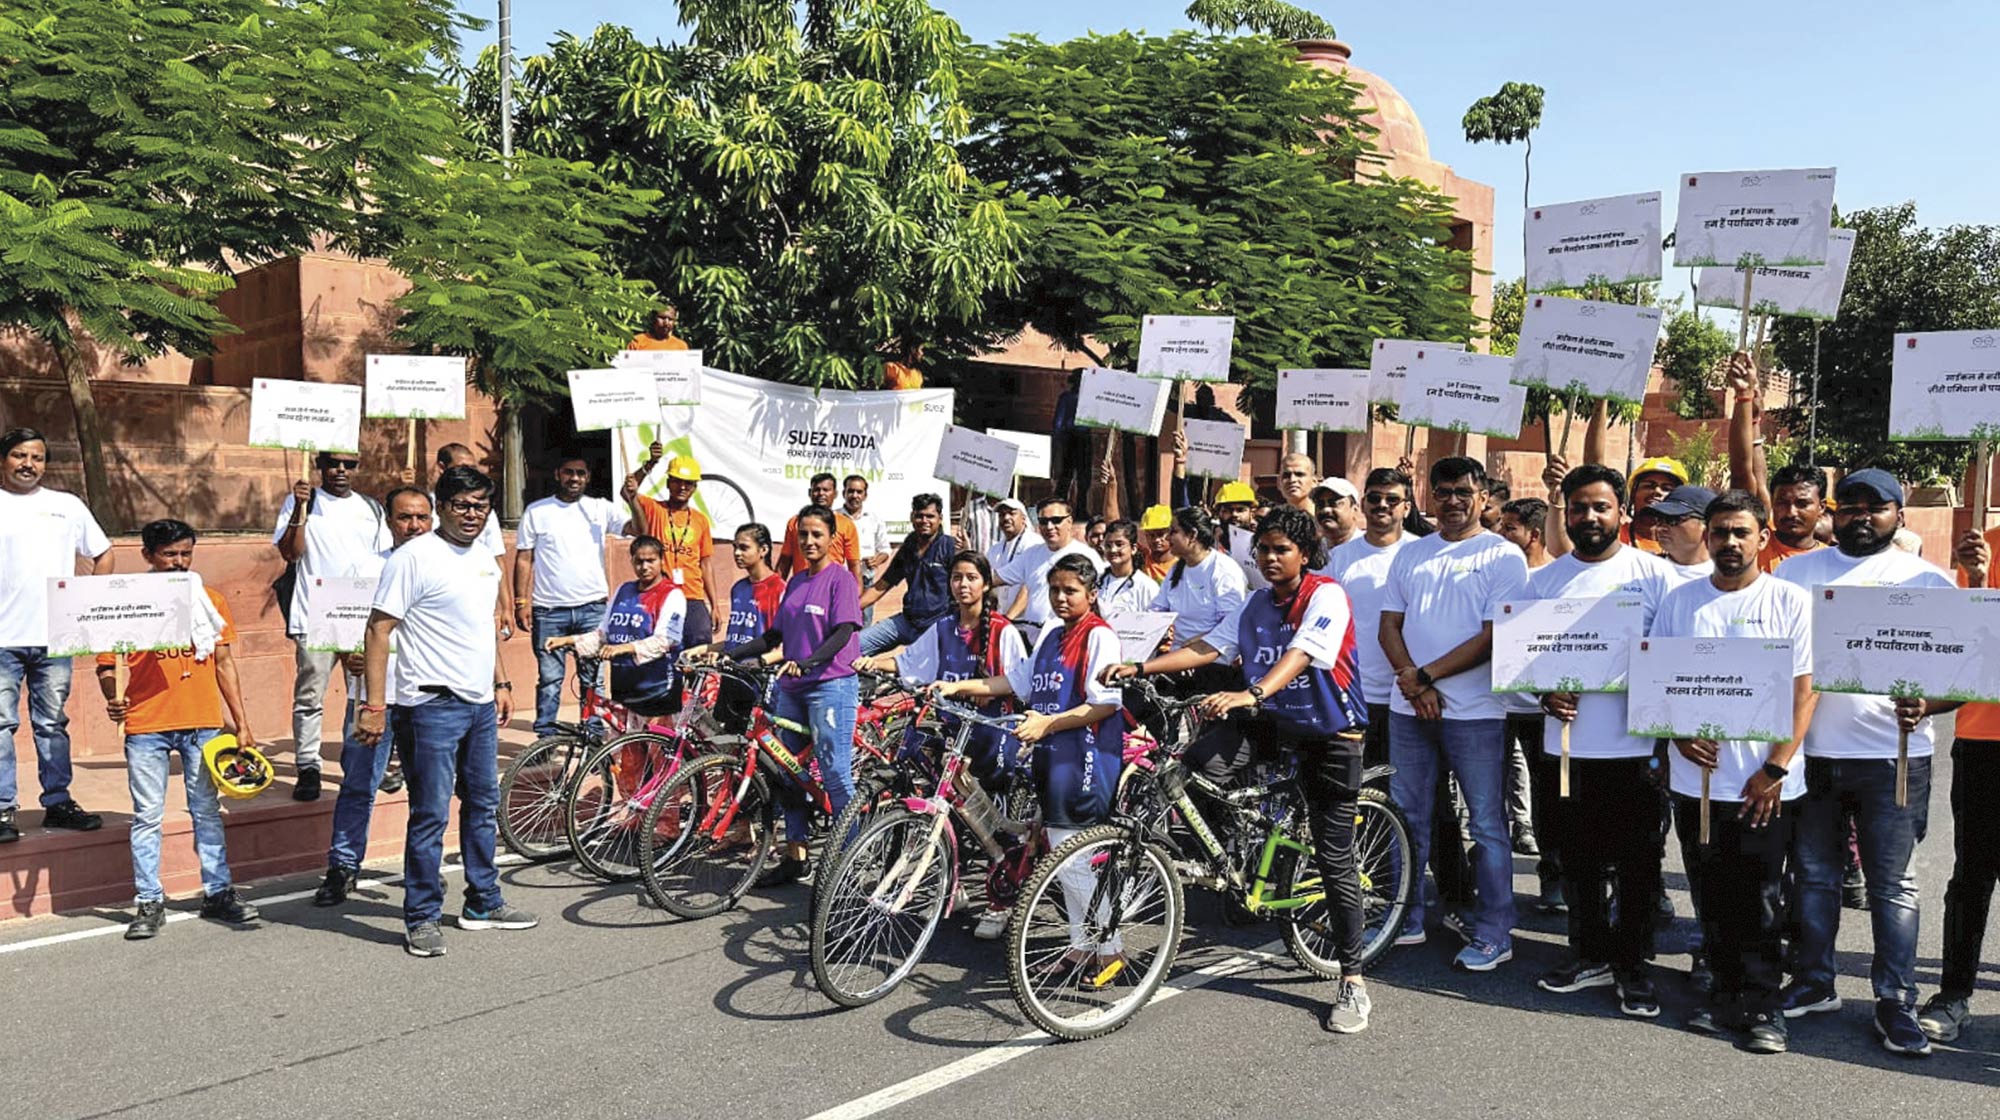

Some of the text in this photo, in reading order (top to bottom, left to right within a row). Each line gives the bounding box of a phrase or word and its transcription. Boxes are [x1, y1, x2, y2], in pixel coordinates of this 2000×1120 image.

[1704, 219, 1718, 229] हम
[1765, 217, 1775, 227] के
[787, 429, 876, 450] SUEZ INDIA
[787, 448, 852, 460] FORCE FOR GOOD
[1551, 642, 1573, 653] रहेगा
[1574, 642, 1609, 652] लखनऊ
[1846, 637, 1964, 654] हम हैं पर्यावरण के रक्षक
[155, 645, 194, 661] sue
[1665, 685, 1753, 698] स्वस्थ रहेगा लखनऊ
